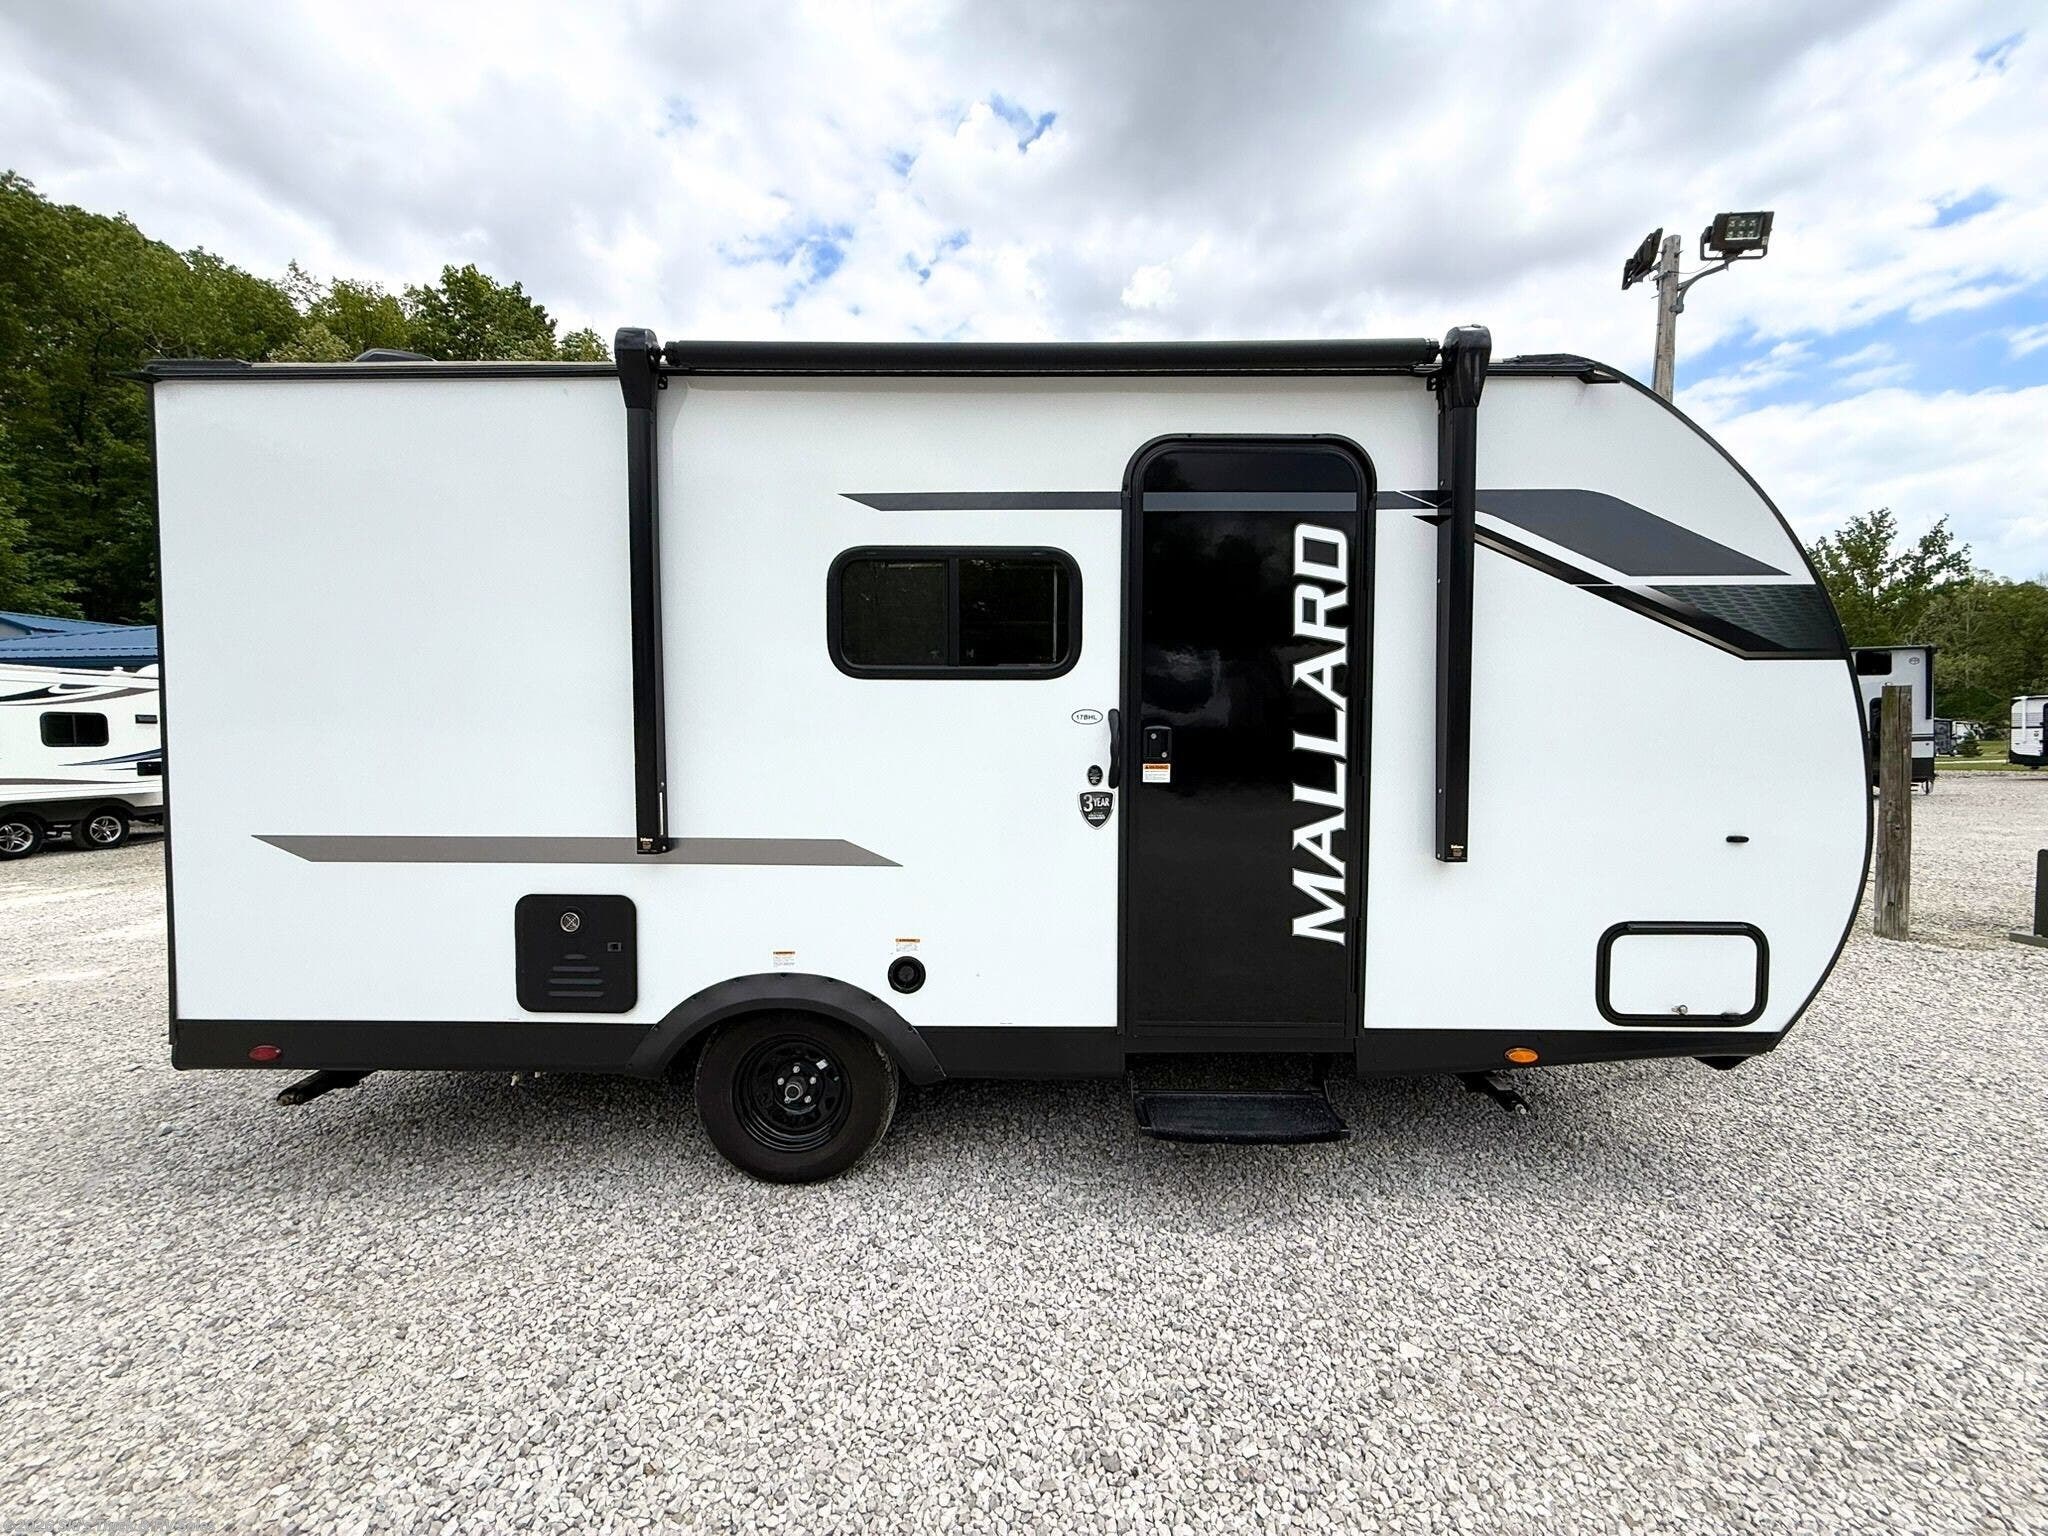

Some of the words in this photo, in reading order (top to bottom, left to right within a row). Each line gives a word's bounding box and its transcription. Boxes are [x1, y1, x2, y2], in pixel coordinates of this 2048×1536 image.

[1083, 794, 1094, 812] 3
[1093, 797, 1110, 807] YEAR
[1291, 523, 1348, 945] MALLARD
